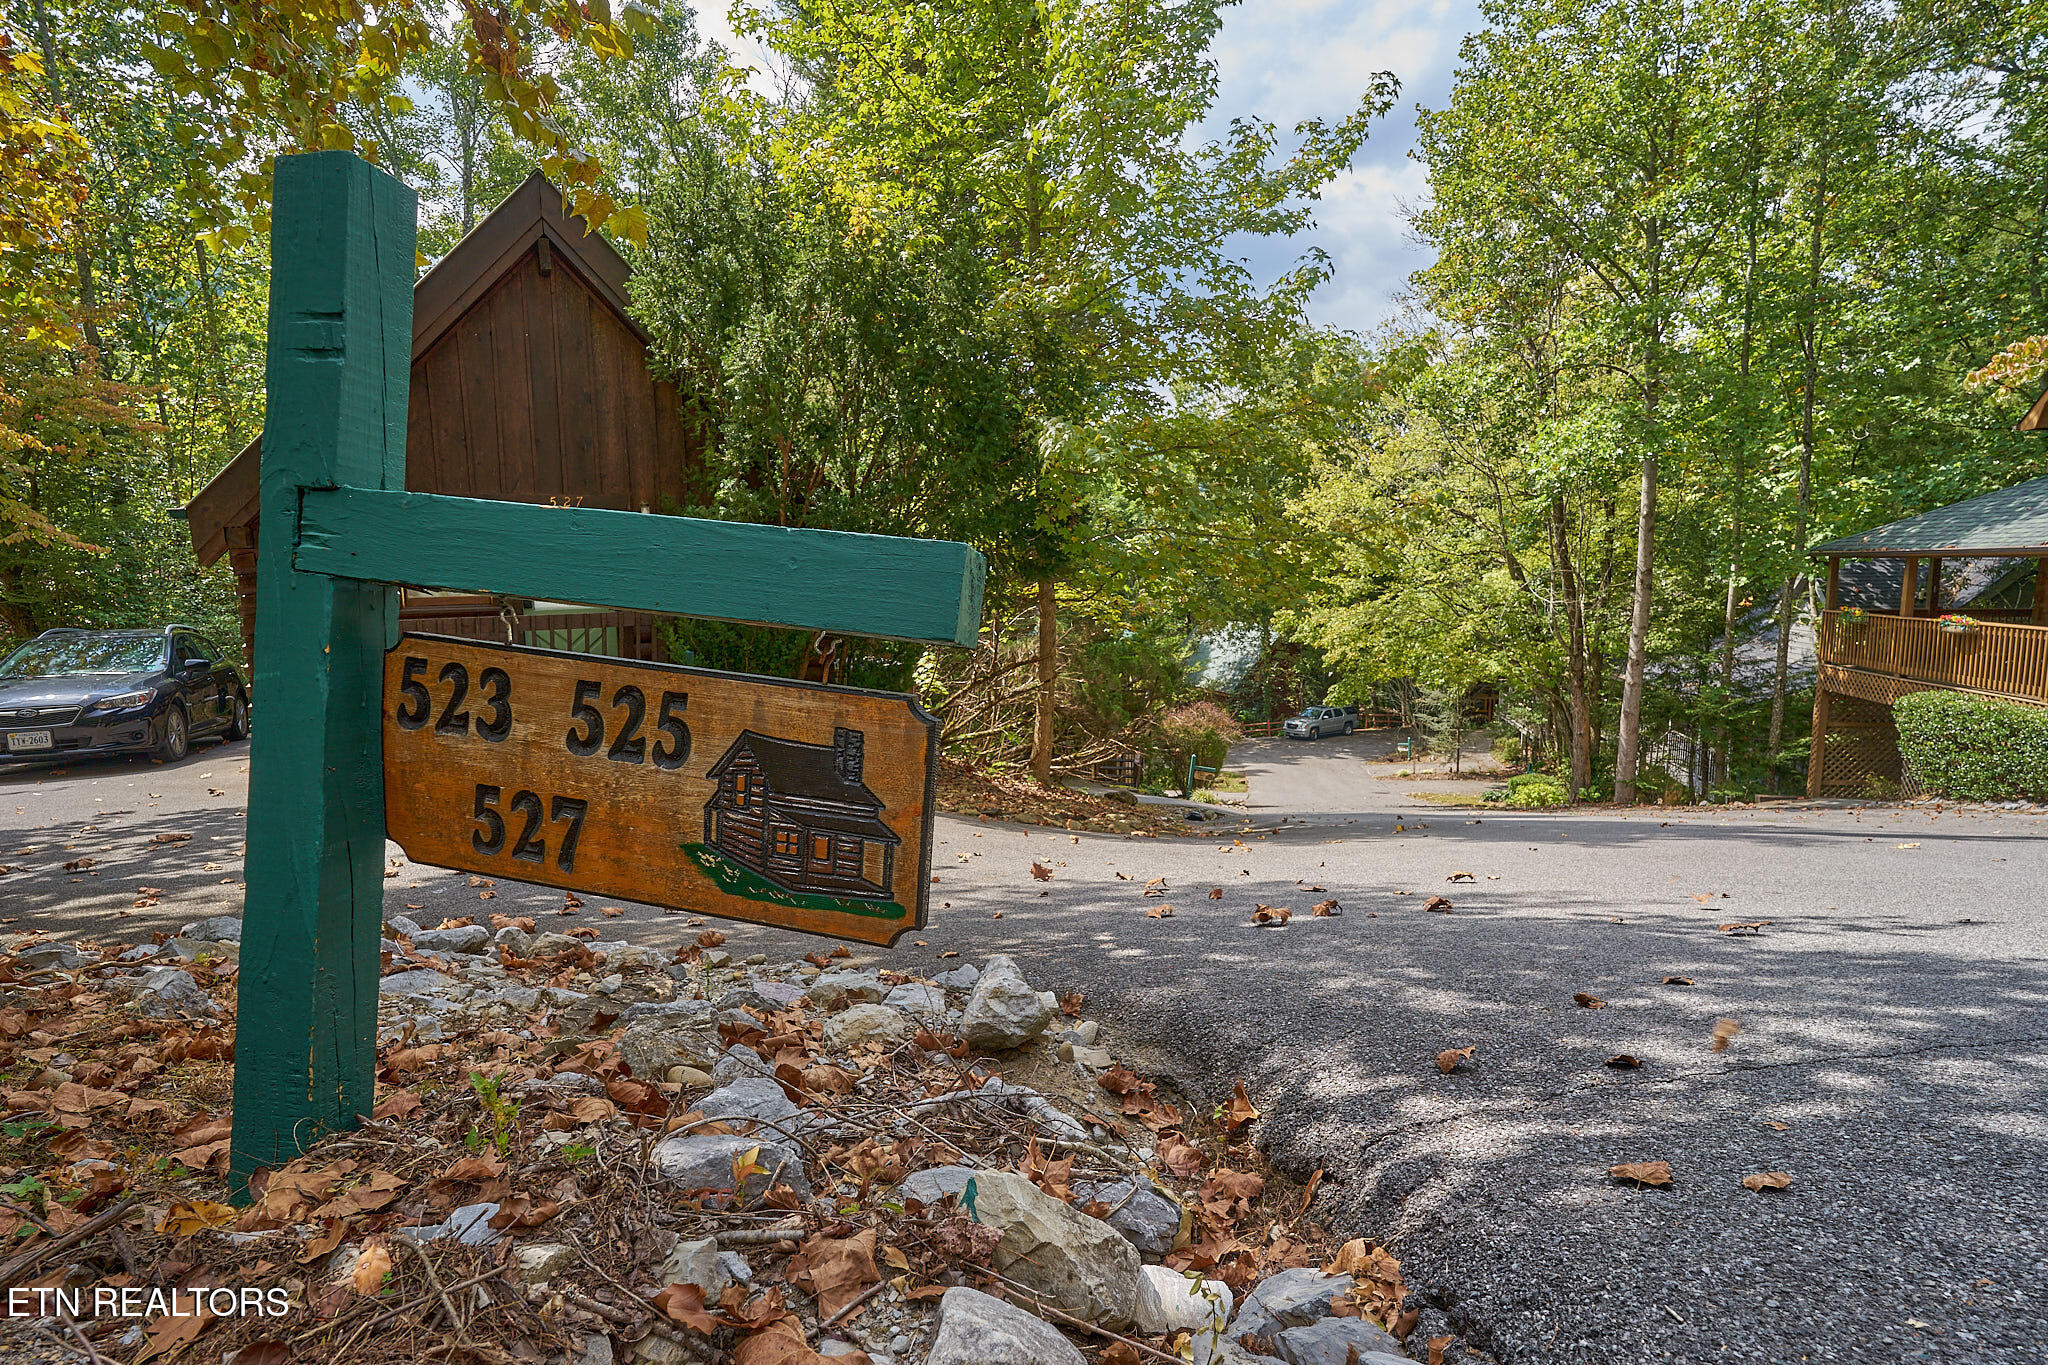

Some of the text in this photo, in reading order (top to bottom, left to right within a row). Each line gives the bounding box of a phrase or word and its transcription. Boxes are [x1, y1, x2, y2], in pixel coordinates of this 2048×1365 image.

[550, 496, 583, 508] 527
[397, 656, 690, 770] 523 525
[471, 783, 588, 874] 527
